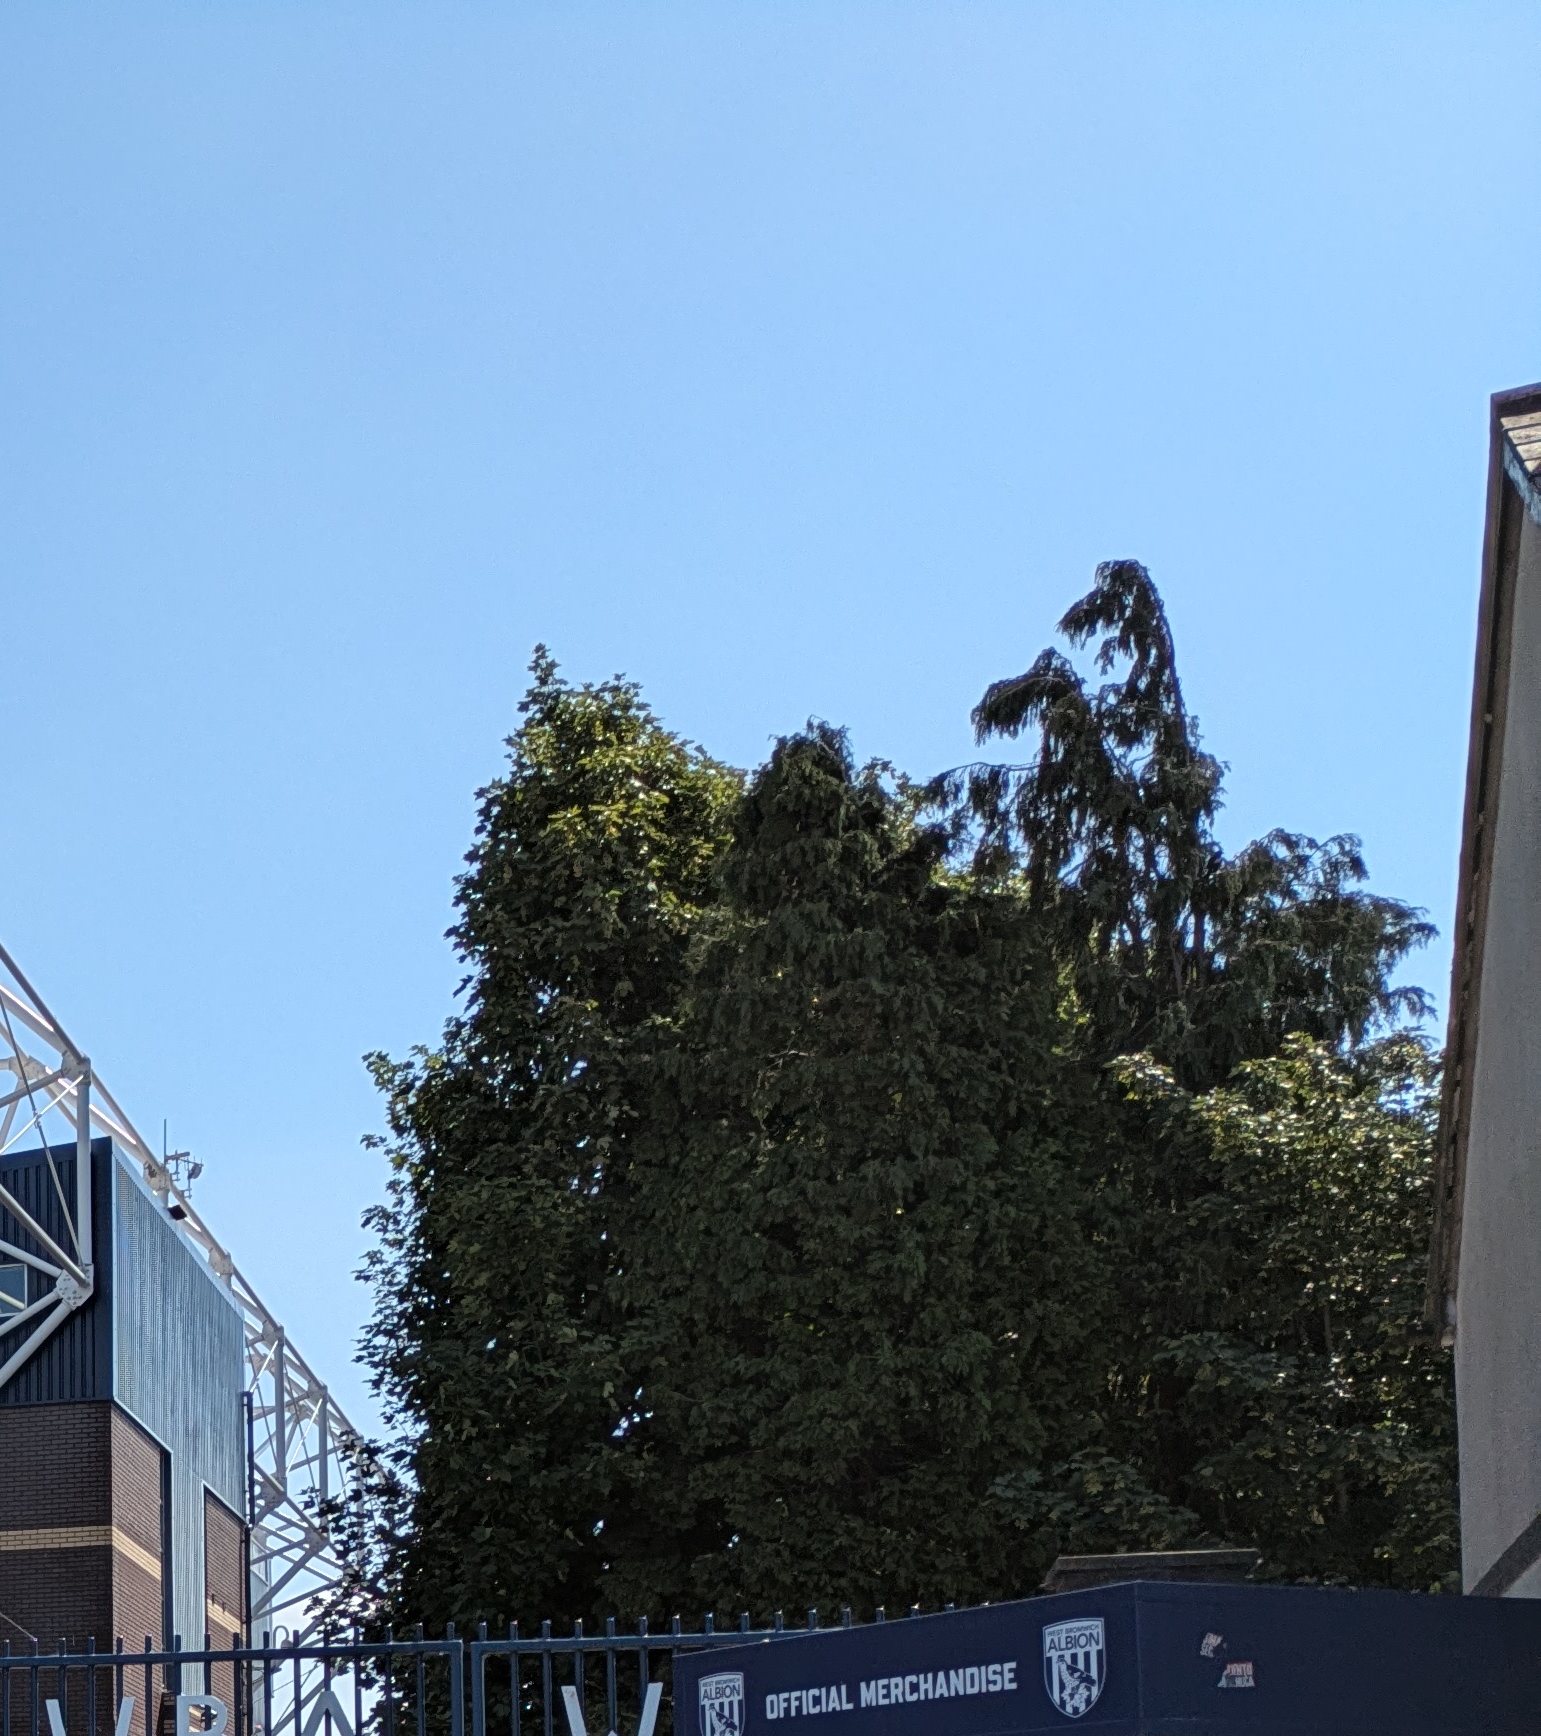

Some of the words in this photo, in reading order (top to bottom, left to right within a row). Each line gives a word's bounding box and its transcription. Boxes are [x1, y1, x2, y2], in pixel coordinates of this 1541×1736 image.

[1047, 1631, 1100, 1653] ALBION
[701, 1683, 740, 1701] ALBION
[765, 1684, 854, 1720] OFFICIAL
[860, 1661, 1018, 1708] MERCHANDISE
